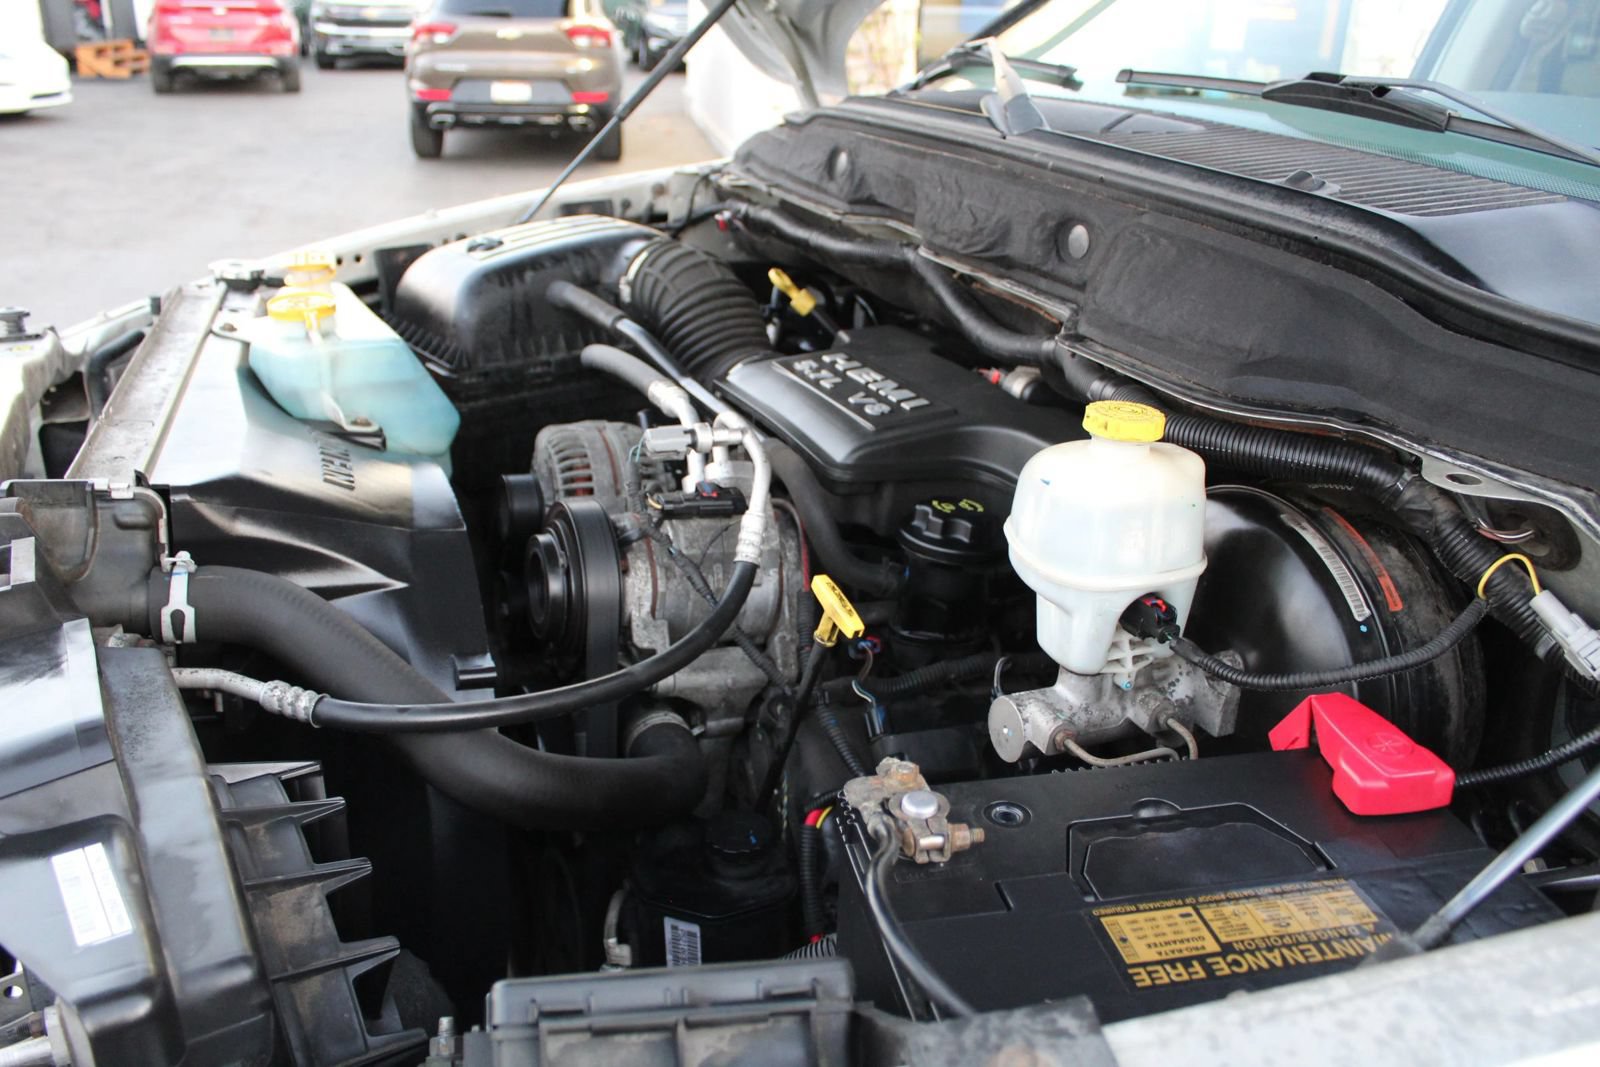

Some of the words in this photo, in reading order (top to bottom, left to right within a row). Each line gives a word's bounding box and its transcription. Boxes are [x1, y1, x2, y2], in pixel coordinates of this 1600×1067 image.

[821, 352, 931, 411] HEMI
[847, 391, 892, 417] V8
[1146, 935, 1206, 949] GUARANTEE
[1233, 928, 1361, 952] DANGER/POISON
[1127, 959, 1208, 988] FREE
